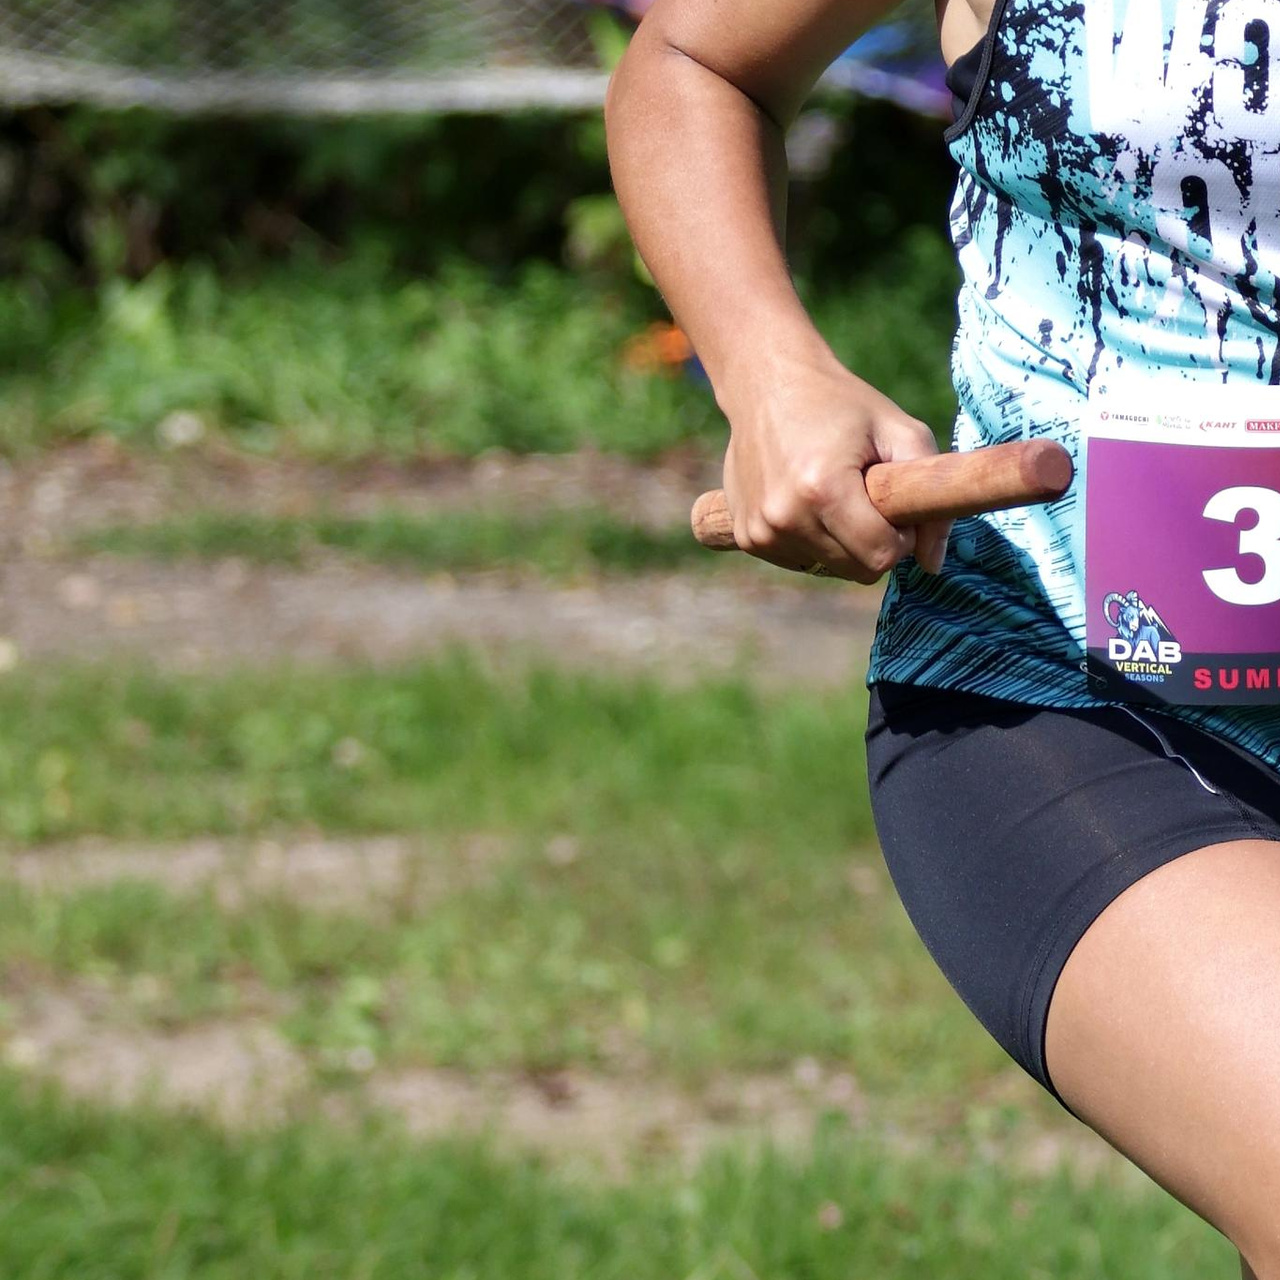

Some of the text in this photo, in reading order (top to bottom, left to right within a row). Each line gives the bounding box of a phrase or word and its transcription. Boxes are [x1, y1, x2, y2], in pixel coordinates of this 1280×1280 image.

[1111, 413, 1149, 423] YAMAGUCHI
[1108, 638, 1182, 664] DAB
[1116, 661, 1172, 675] VERTICAL
[1125, 673, 1165, 683] SEASONS
